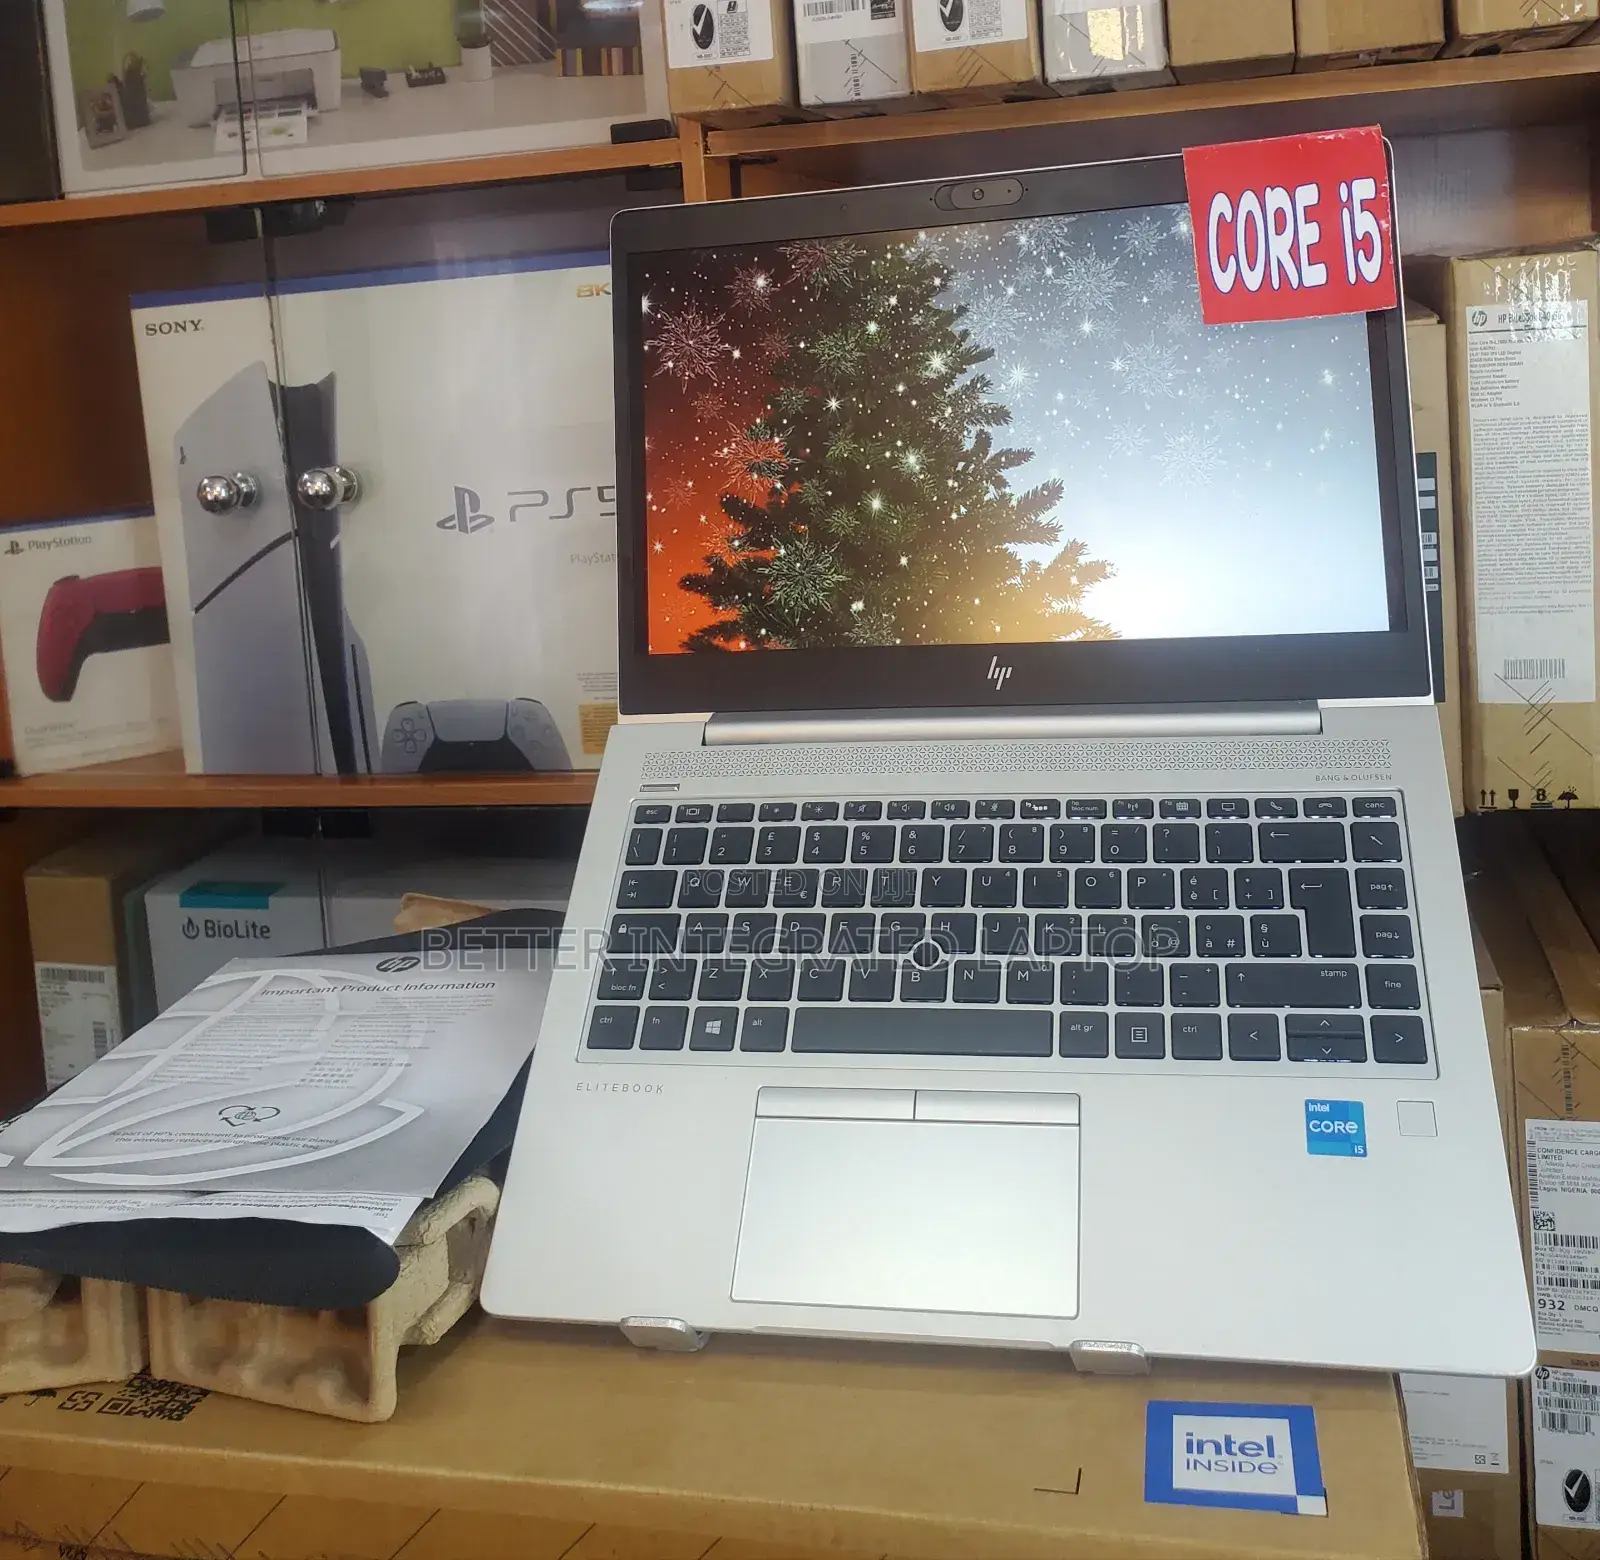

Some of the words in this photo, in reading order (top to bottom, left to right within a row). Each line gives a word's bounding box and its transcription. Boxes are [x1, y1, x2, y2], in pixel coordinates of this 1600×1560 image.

[1207, 182, 1327, 294] CORE
[1339, 178, 1382, 285] i5
[577, 284, 611, 297] 8K
[145, 319, 202, 336] SONY
[28, 536, 92, 550] PlayStation
[570, 552, 616, 565] PlayStat
[987, 655, 1013, 690] hp
[768, 832, 775, 841] £
[814, 832, 820, 841] $
[862, 832, 870, 840] %
[909, 831, 917, 839] &
[718, 848, 725, 856] 2
[764, 847, 772, 855] 3
[812, 847, 819, 855] 4
[860, 846, 867, 854] 5
[909, 846, 915, 854] 6
[958, 846, 965, 854] 7
[1008, 846, 1016, 854] 8
[1060, 846, 1067, 854] 9
[689, 877, 700, 888] Q
[737, 876, 751, 887] W
[783, 876, 792, 886] E
[832, 876, 841, 886] R
[881, 876, 890, 885] T
[931, 875, 941, 886] Y
[982, 875, 991, 886] U
[1137, 877, 1146, 887] P
[1370, 883, 1387, 892] pag
[204, 918, 271, 940] BioLite
[694, 921, 704, 931] A
[741, 921, 750, 931] S
[790, 921, 799, 931] D
[840, 921, 847, 931] F
[891, 921, 900, 932] G
[941, 921, 950, 932] H
[992, 922, 1000, 933] J
[1045, 923, 1055, 933] K
[1098, 923, 1106, 933] L
[1375, 931, 1393, 940] pag
[1226, 938, 1235, 948] #
[376, 956, 421, 973] hp
[709, 968, 717, 978] Z
[758, 969, 768, 979] X
[809, 969, 819, 979] C
[860, 969, 870, 979] V
[911, 972, 920, 982] B
[964, 970, 974, 980] N
[1018, 970, 1029, 981] M
[1320, 969, 1347, 978] stamp
[261, 986, 338, 996] Important
[340, 984, 401, 993] Product
[404, 981, 496, 991] Information
[1385, 980, 1402, 989] fine
[1070, 1023, 1081, 1031] alt
[1083, 1025, 1093, 1034] gr
[1183, 1025, 1197, 1033] ctrl
[576, 1083, 663, 1094] ELITEBOOK
[1309, 1103, 1329, 1112] intel
[1354, 1145, 1364, 1153] i5
[1538, 1299, 1565, 1310] 932
[1535, 1367, 1549, 1380] hp
[1186, 1432, 1275, 1458] intel
